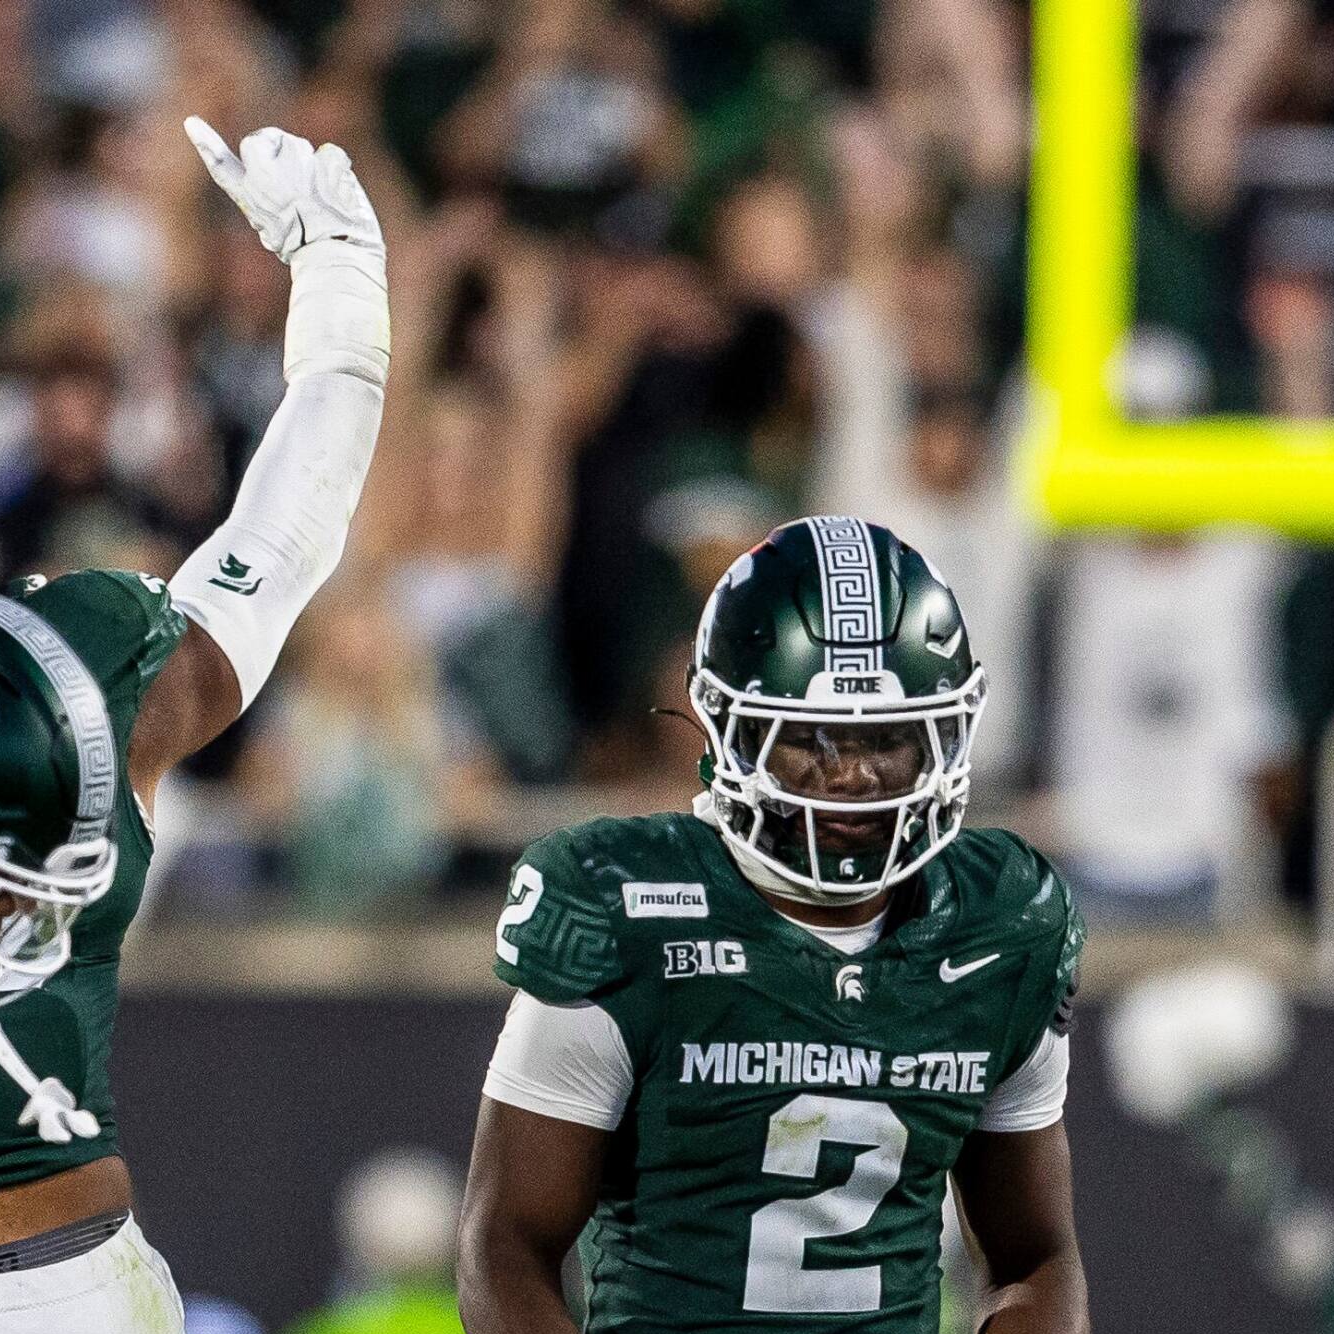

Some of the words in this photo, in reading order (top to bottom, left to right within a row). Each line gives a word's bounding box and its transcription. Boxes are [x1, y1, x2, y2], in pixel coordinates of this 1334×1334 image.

[832, 676, 883, 694] STATE
[495, 863, 545, 967] 2
[639, 890, 705, 907] msufcu
[678, 1041, 883, 1087] MICHIGAN
[889, 1050, 992, 1094] STATE
[742, 1093, 910, 1314] 2
